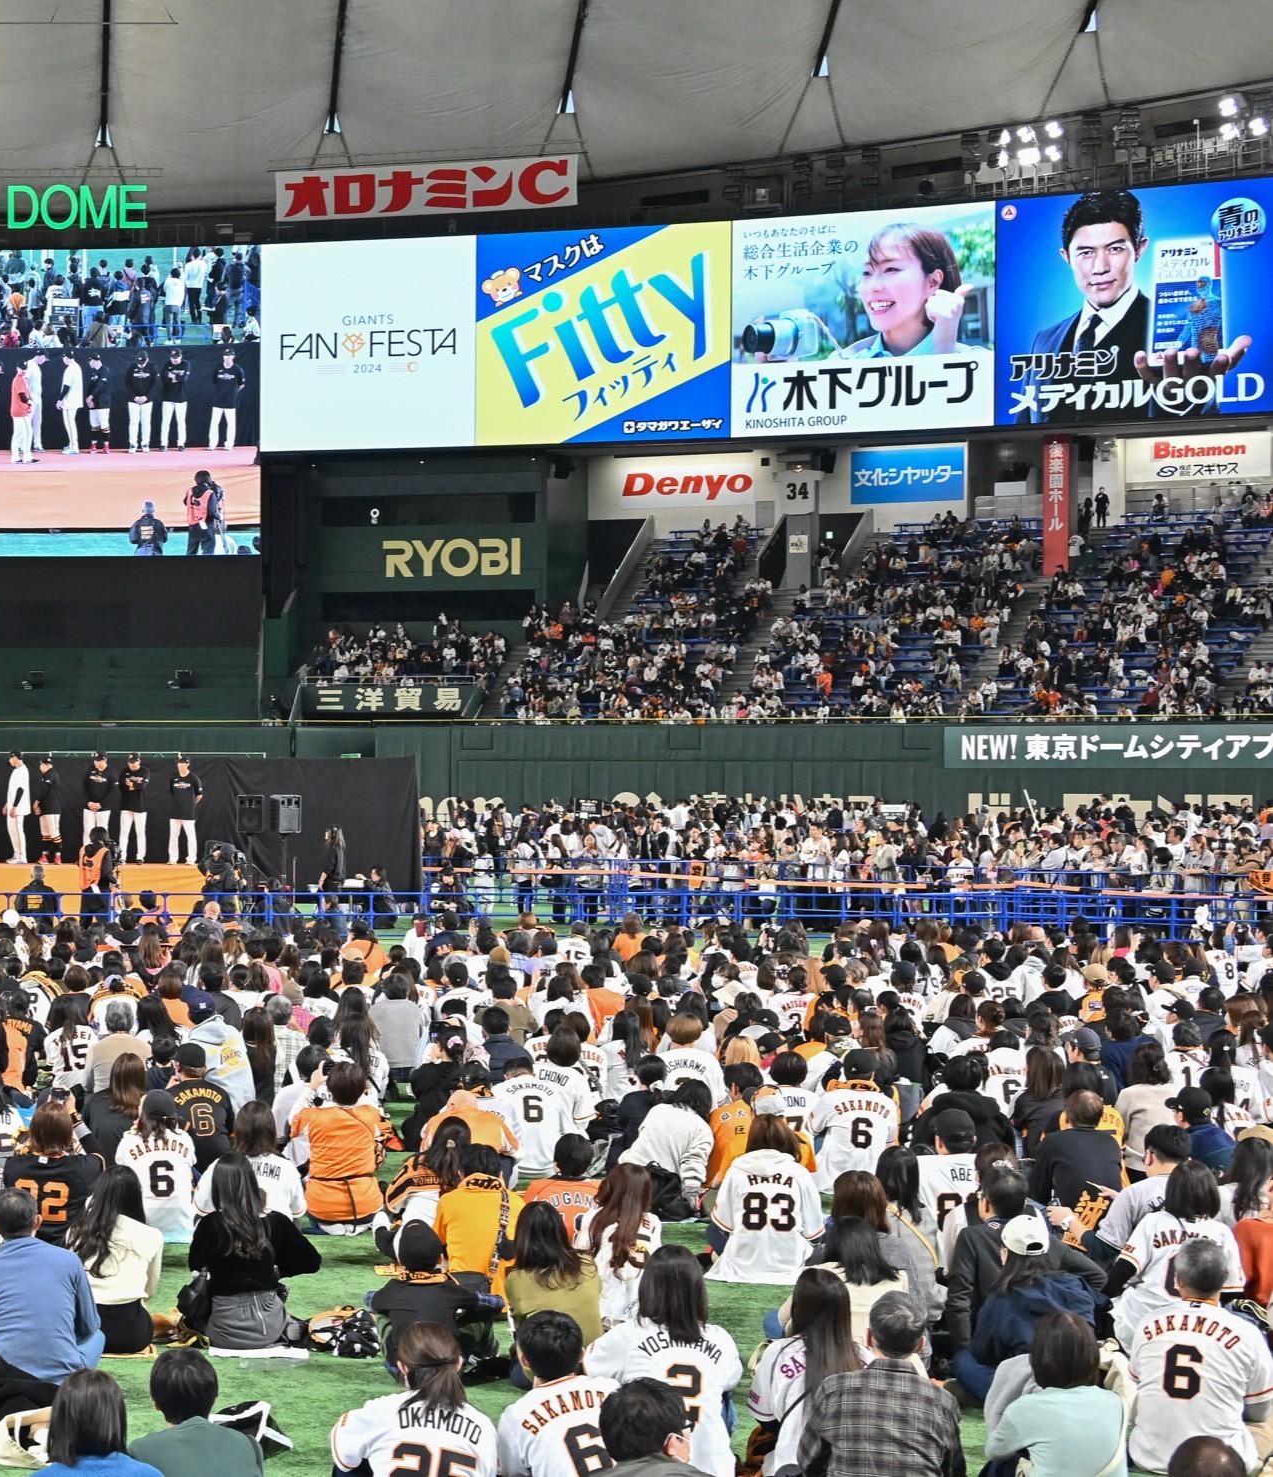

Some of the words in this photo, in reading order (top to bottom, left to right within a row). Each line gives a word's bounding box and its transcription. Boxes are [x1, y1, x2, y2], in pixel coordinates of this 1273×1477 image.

[284, 158, 570, 217] オロナミンC
[7, 184, 148, 229] DOME
[523, 233, 604, 284] マスクは
[743, 239, 858, 260] 総合生活企業の
[743, 260, 835, 280] 木下グループ
[342, 314, 394, 326] GIANTS
[491, 249, 711, 409] Fitty
[279, 332, 338, 360] FAN
[370, 327, 457, 358] FESTA
[353, 363, 382, 374] 2024
[1009, 345, 1120, 381] アリナミン
[563, 350, 677, 422] フィッティ
[783, 361, 979, 411] 木下グループ
[636, 418, 724, 433] タマガワエーザイ
[745, 416, 805, 430] KINOSHITA
[809, 414, 848, 427] GROUP
[1153, 442, 1247, 461] Bishamon
[1193, 461, 1239, 476] スギヤス
[622, 472, 753, 500] Denyo
[786, 482, 809, 500] 34
[382, 537, 521, 578] RYOBI
[317, 689, 462, 711] 三洋貿易
[961, 733, 1017, 760] NEW!
[1025, 733, 1273, 760] 東京ドームシティアプ
[1226, 962, 1236, 980] 8
[506, 1083, 554, 1097] SAKAMOTO
[539, 1068, 569, 1086] CHONO
[174, 1088, 222, 1106] SAKAMOTO
[522, 1096, 543, 1123] 6
[834, 1098, 890, 1117] SAKAMOTO
[190, 1102, 216, 1137] 6
[851, 1117, 873, 1149] 6
[129, 1138, 189, 1158] SAKAMOTO
[150, 1160, 175, 1198] 6
[747, 1173, 794, 1189] HARA
[950, 1167, 974, 1182] ABE
[742, 1192, 795, 1231] 83
[1143, 1314, 1241, 1350] SAKAMOTO
[1162, 1344, 1204, 1400] 6
[521, 1388, 616, 1436] SAKAMOT
[397, 1407, 482, 1445] OKAMOTO
[391, 1441, 478, 1477] 25
